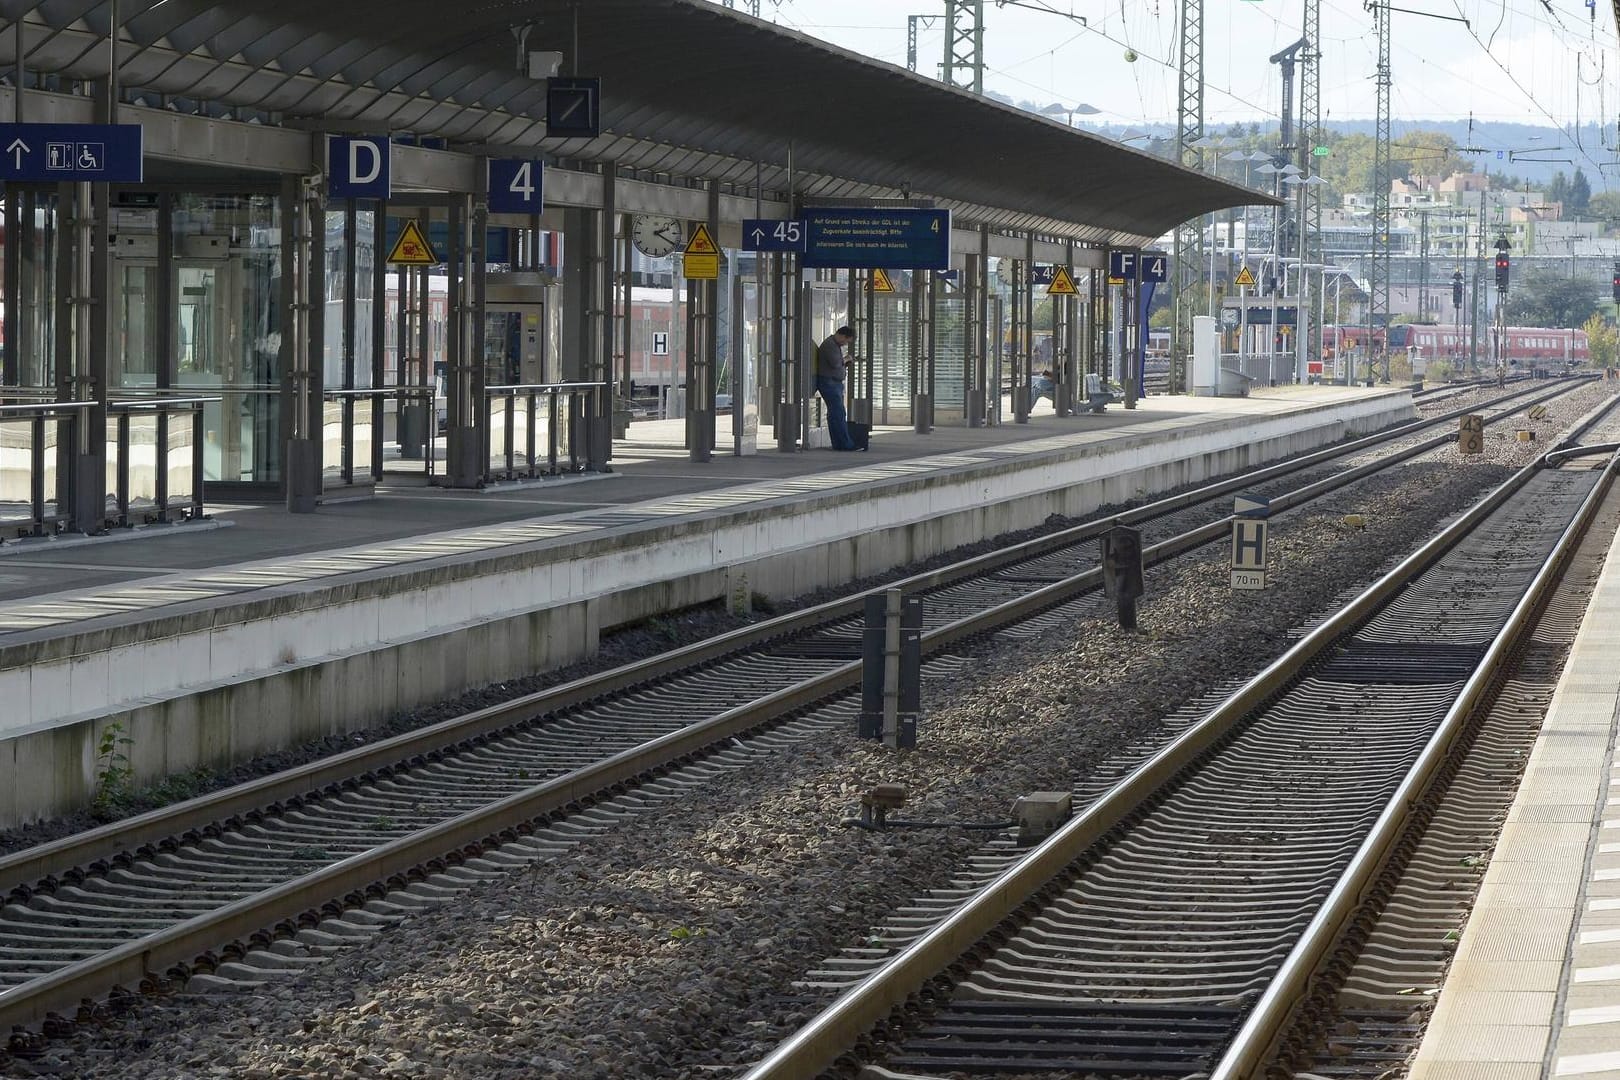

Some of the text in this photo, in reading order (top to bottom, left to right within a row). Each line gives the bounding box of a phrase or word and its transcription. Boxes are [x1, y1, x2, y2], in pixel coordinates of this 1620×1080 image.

[348, 140, 381, 185] D
[509, 162, 536, 201] 4
[773, 222, 800, 243] 45
[930, 219, 940, 233] 4
[1121, 254, 1134, 274] F
[1151, 258, 1164, 277] 4
[654, 333, 667, 353] H
[1461, 416, 1483, 433] 43
[1467, 434, 1478, 450] 6
[1235, 522, 1264, 565] H
[1235, 575, 1260, 585] 70 m
